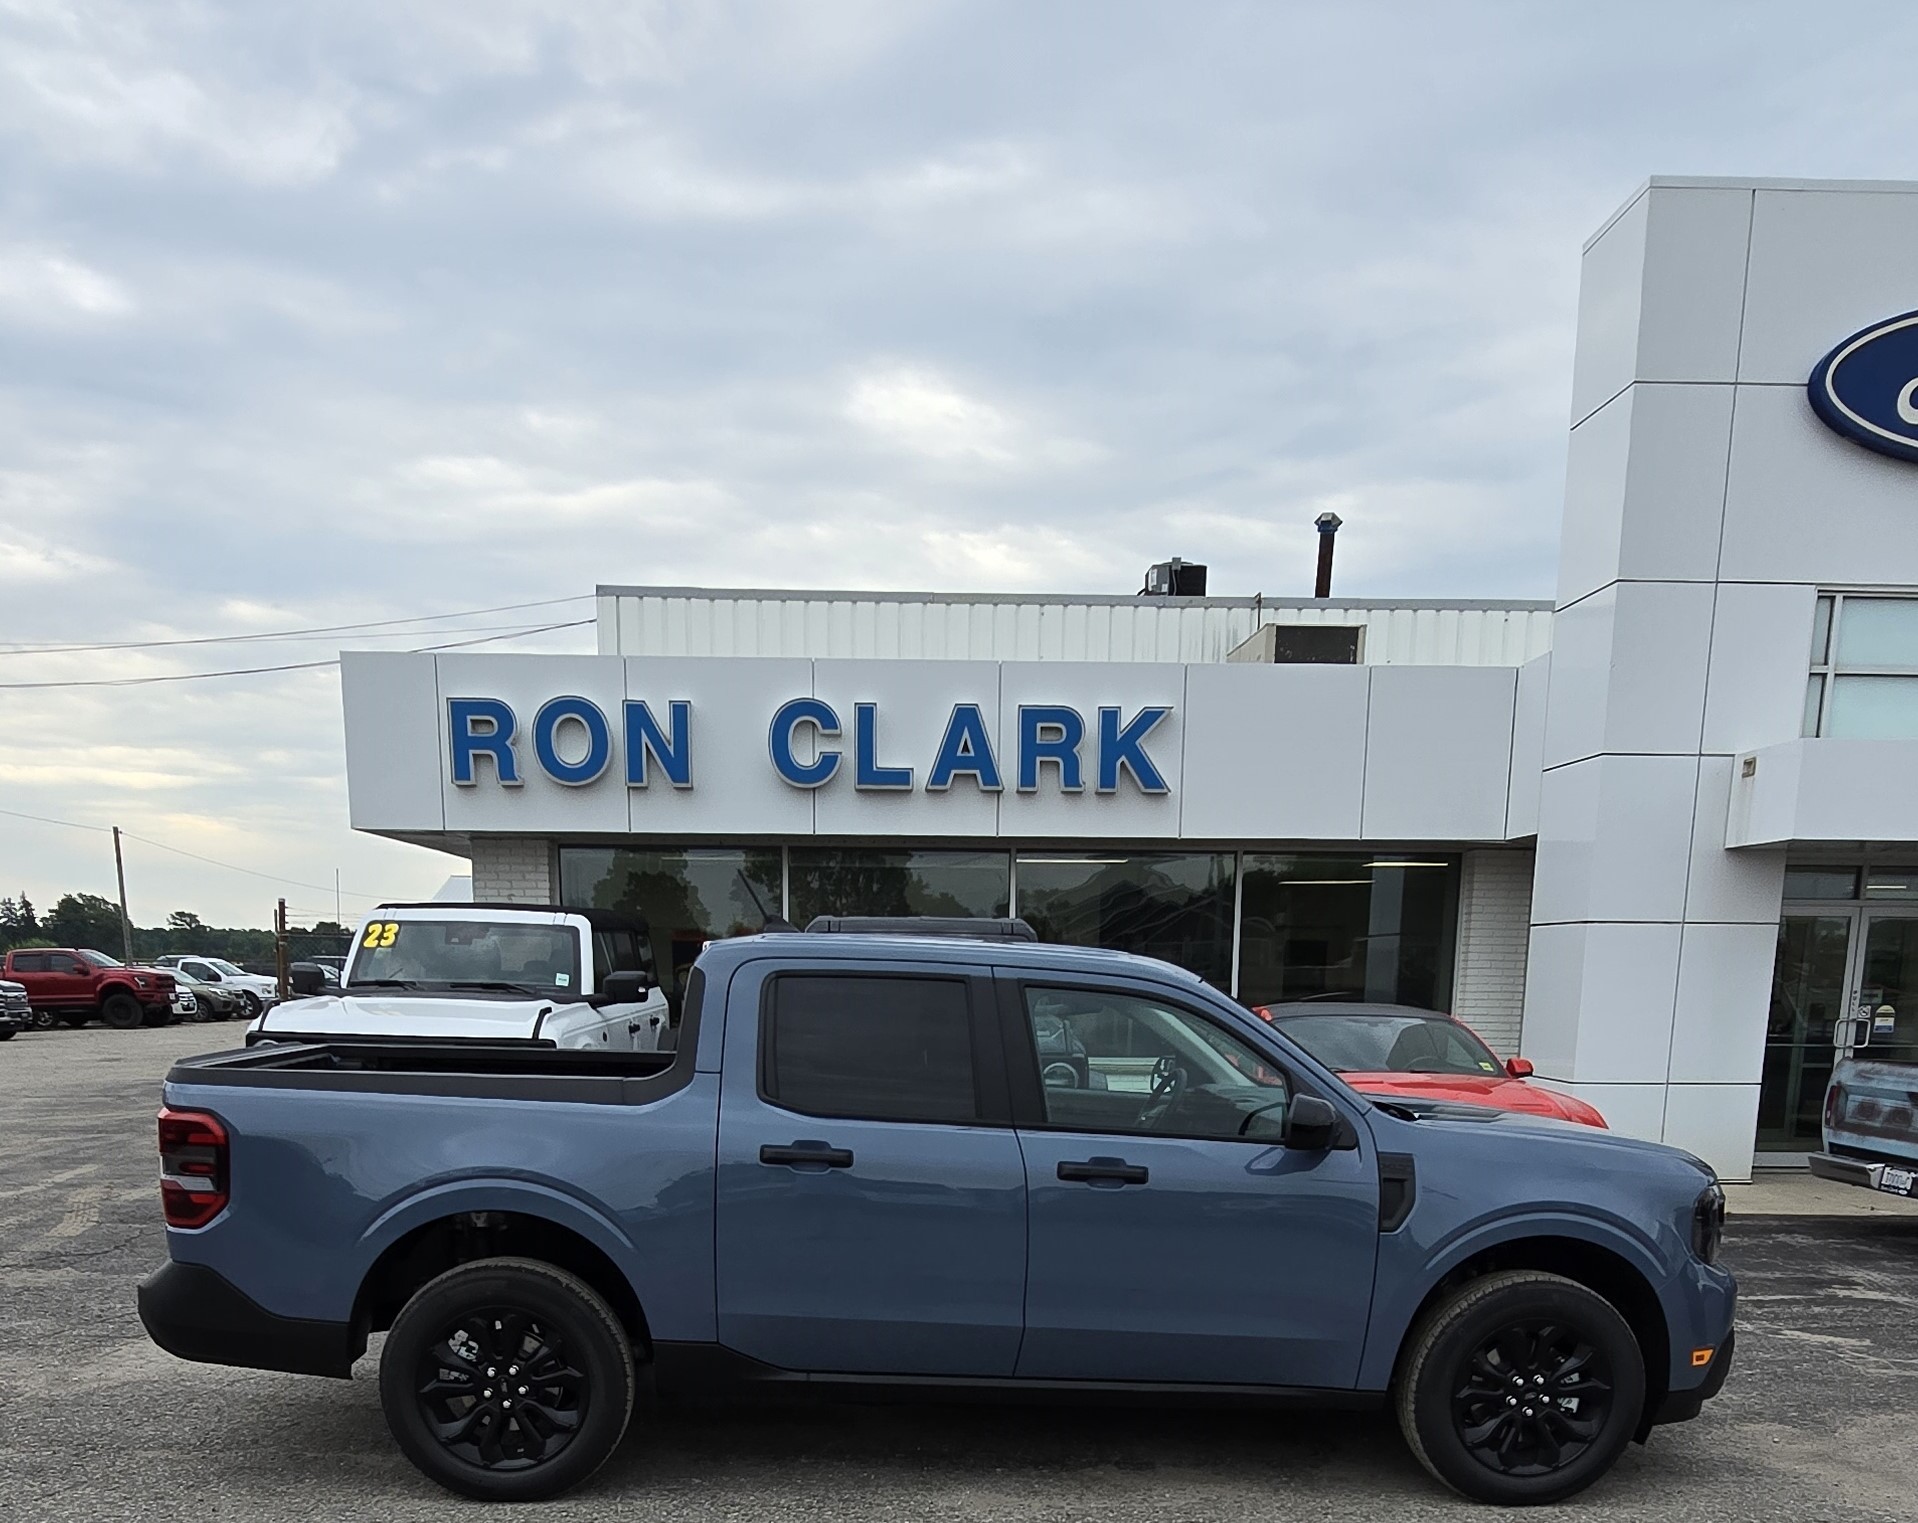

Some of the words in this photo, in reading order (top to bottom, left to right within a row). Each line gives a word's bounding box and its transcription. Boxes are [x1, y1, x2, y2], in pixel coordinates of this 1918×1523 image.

[446, 695, 693, 789] RON
[768, 697, 1173, 794] CLARK
[363, 923, 399, 947] 23
